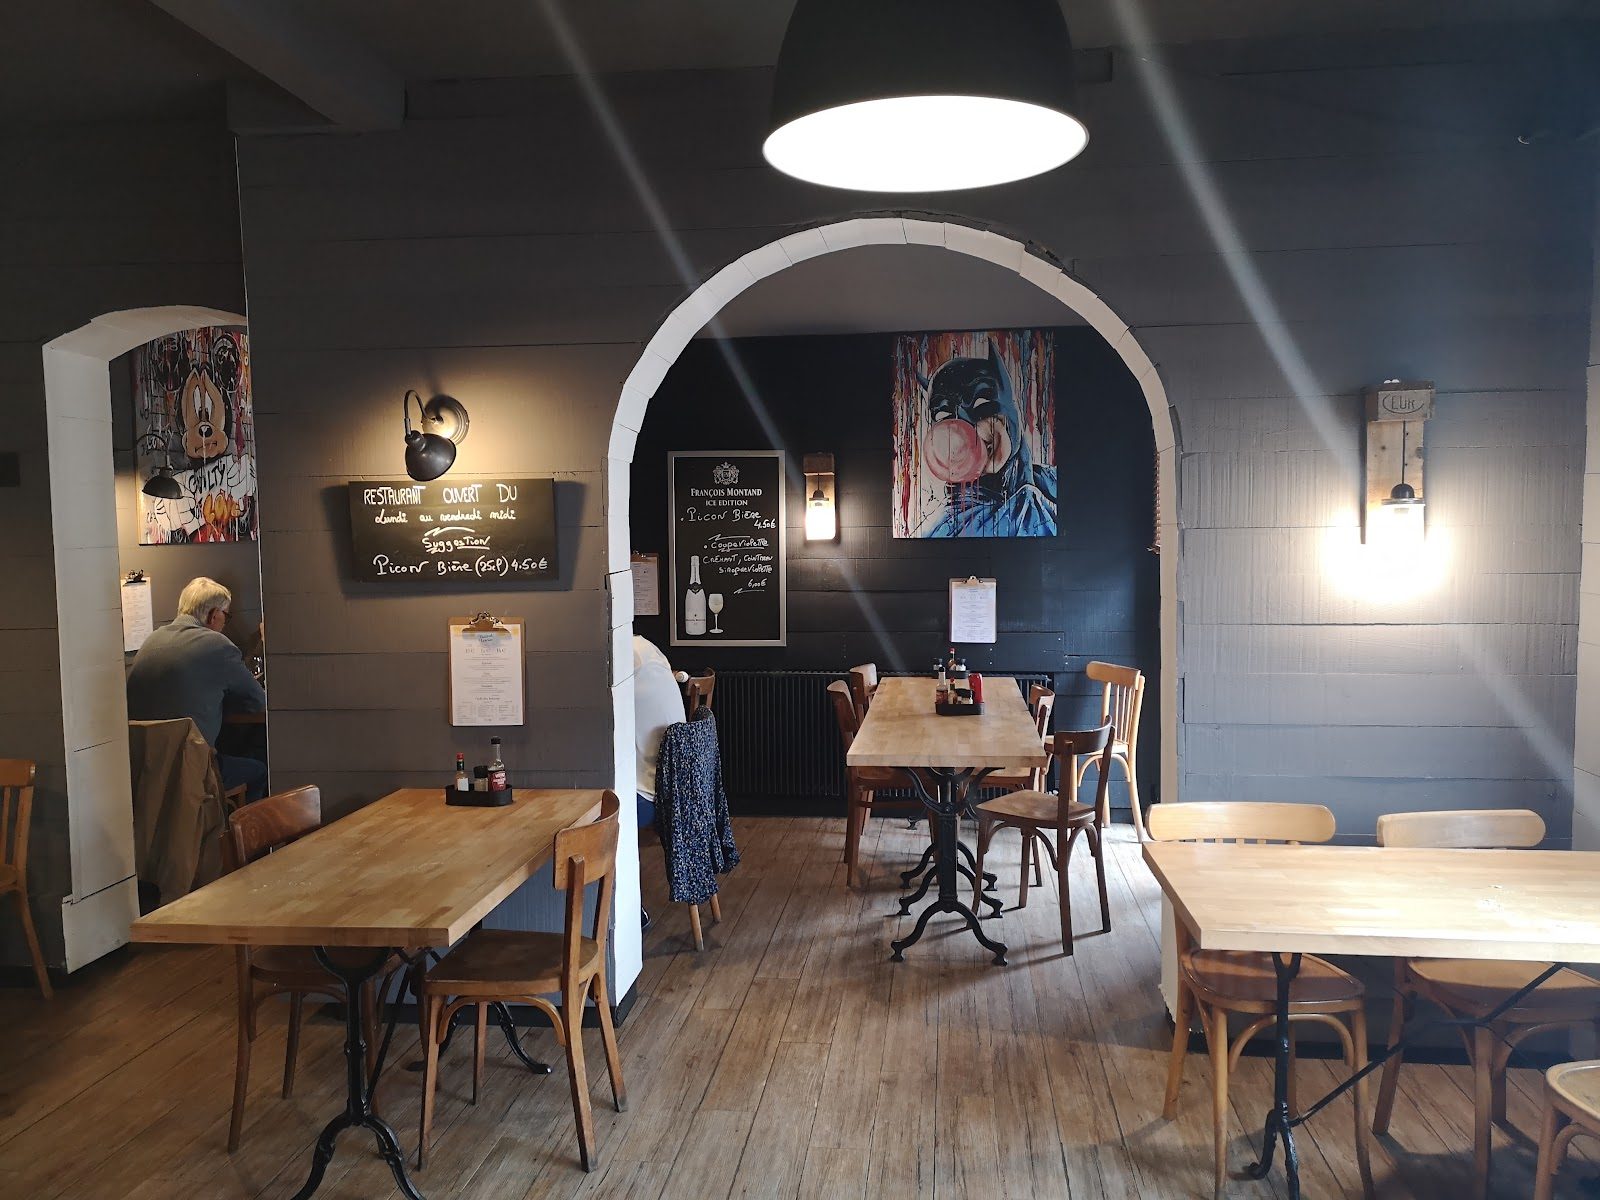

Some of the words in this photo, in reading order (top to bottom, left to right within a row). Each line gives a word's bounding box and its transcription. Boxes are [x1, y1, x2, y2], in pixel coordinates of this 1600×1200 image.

[188, 460, 226, 494] GUILTY
[363, 485, 426, 505] RESTAURANT
[443, 484, 482, 504] OUVERT
[496, 484, 518, 503] DU
[726, 488, 762, 497] MONTAND
[375, 509, 408, 524] Lundi
[440, 509, 482, 522] vendredi
[490, 508, 516, 520] midi
